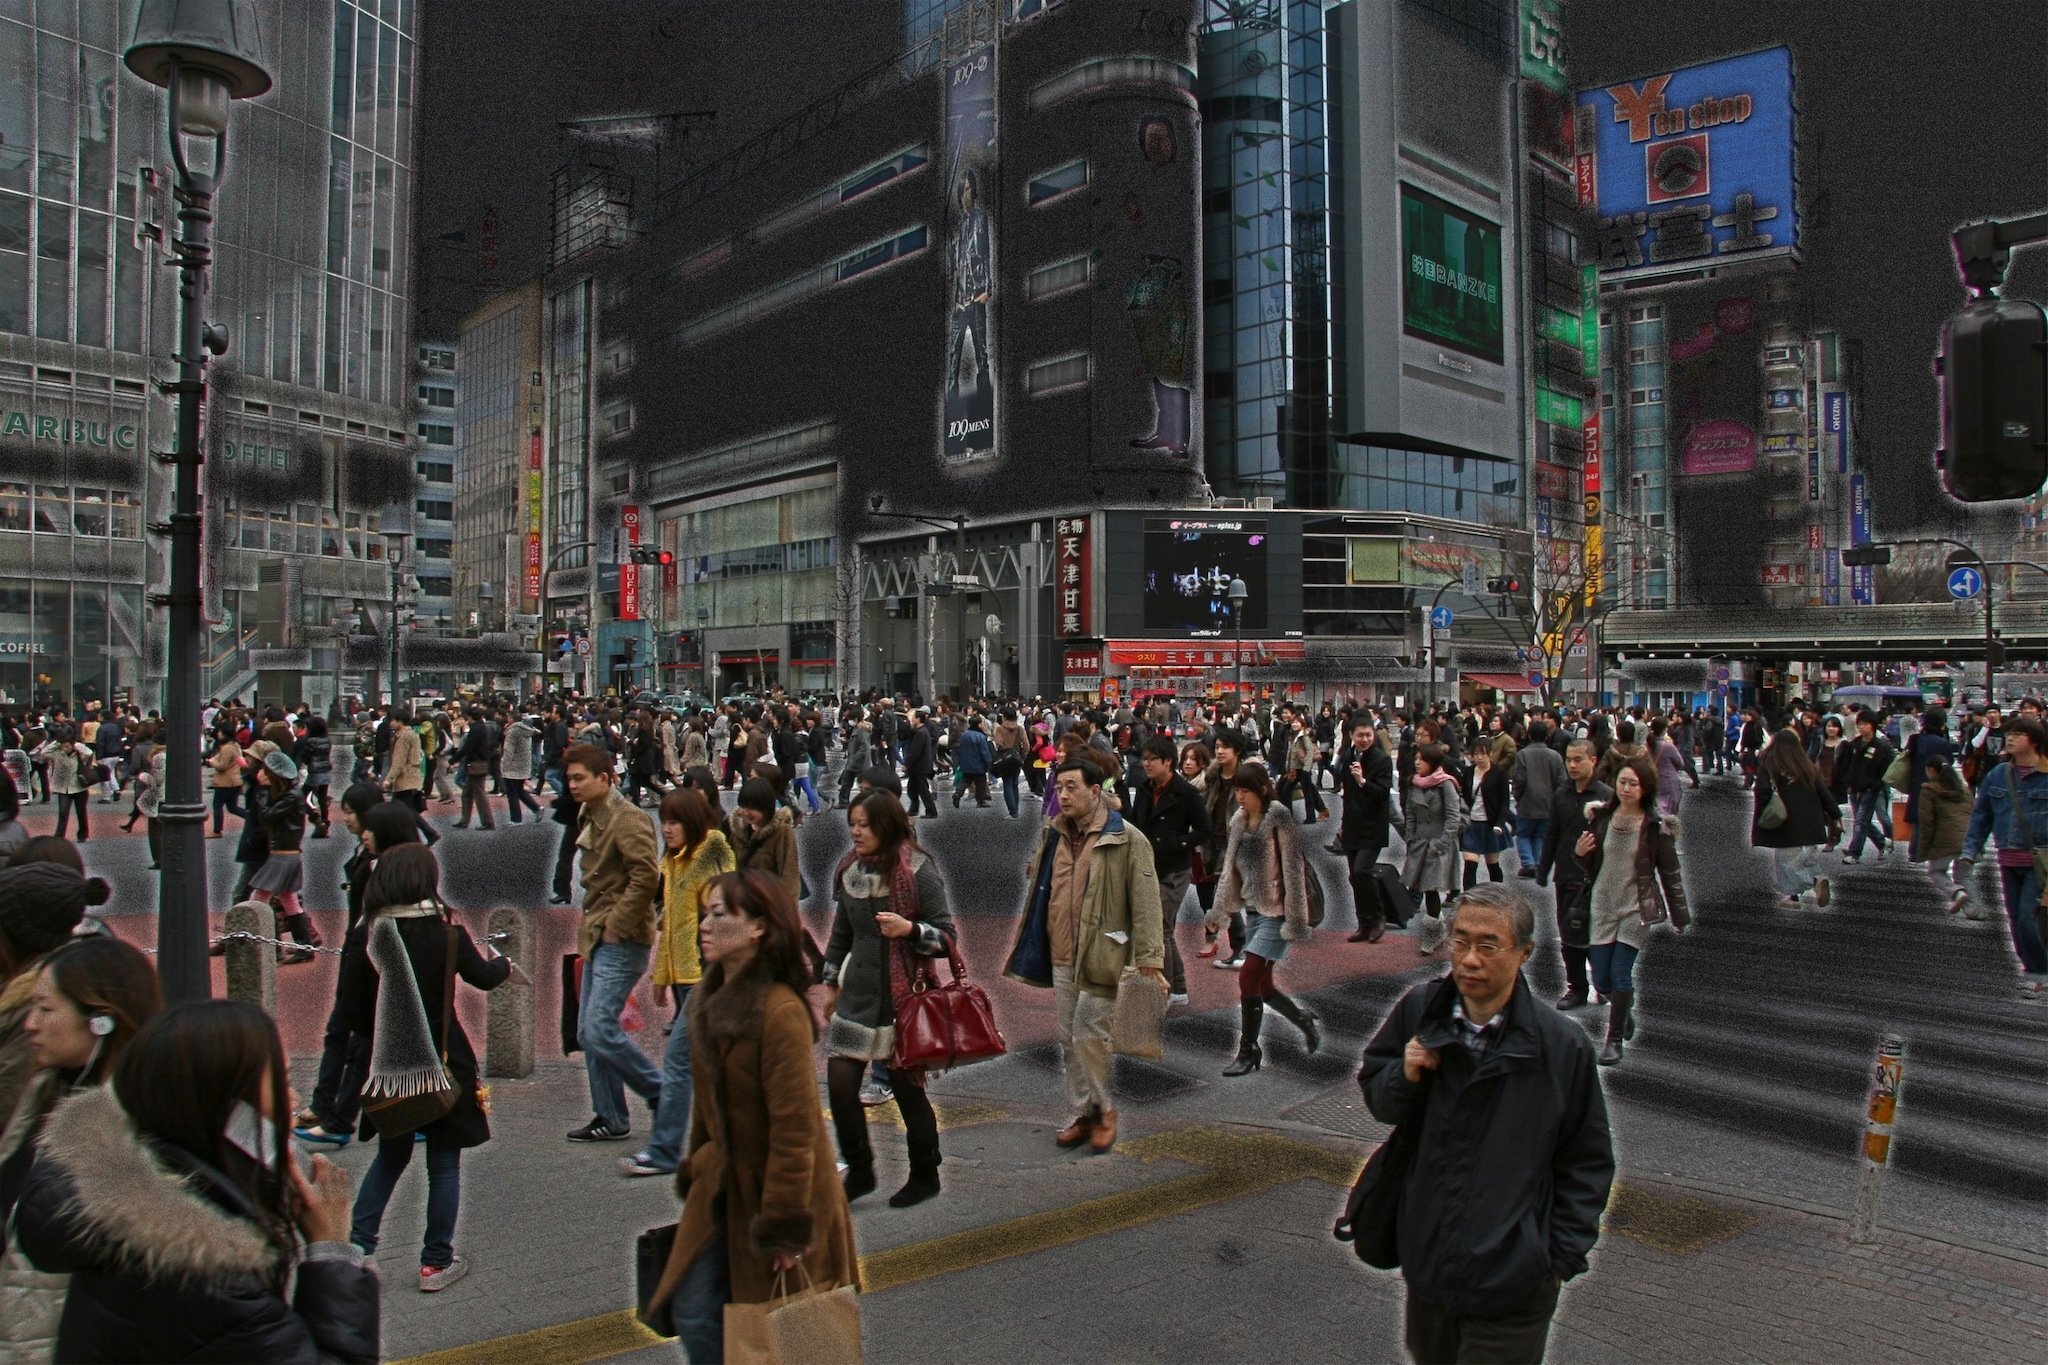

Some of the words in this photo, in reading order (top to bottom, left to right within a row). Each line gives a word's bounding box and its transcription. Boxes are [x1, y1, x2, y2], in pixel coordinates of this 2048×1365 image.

[1689, 94, 1752, 129] shop
[1832, 397, 1840, 430] MIZUHO
[1585, 427, 1598, 464] アコム
[1057, 519, 1085, 534] 名物
[1062, 537, 1081, 634] 天津甘栗
[1066, 657, 1099, 669] 天津甘栗
[1166, 651, 1251, 663] 三千里薬品
